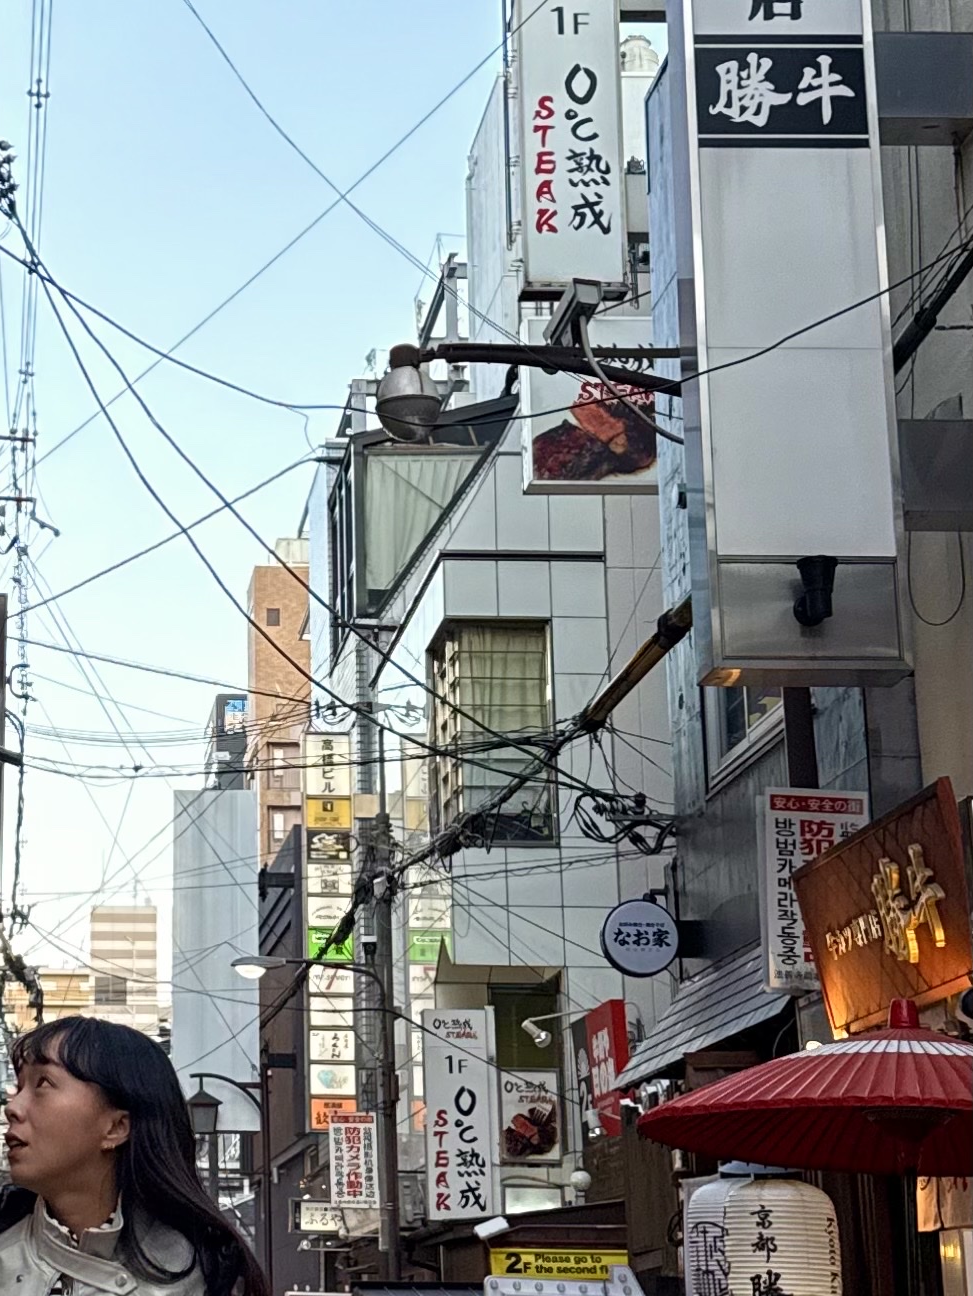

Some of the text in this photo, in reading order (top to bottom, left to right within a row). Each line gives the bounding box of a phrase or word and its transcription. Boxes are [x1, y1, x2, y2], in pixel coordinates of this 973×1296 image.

[550, 6, 590, 36] 1F
[709, 52, 855, 127] 勝牛
[533, 96, 558, 234] STEAK
[613, 928, 672, 948] なお家
[445, 1055, 469, 1074] 1F
[433, 1109, 451, 1211] STEAK
[505, 1252, 531, 1274] 2F
[534, 1254, 602, 1264] Please go to
[535, 1265, 553, 1274] the
[556, 1265, 598, 1274] second
